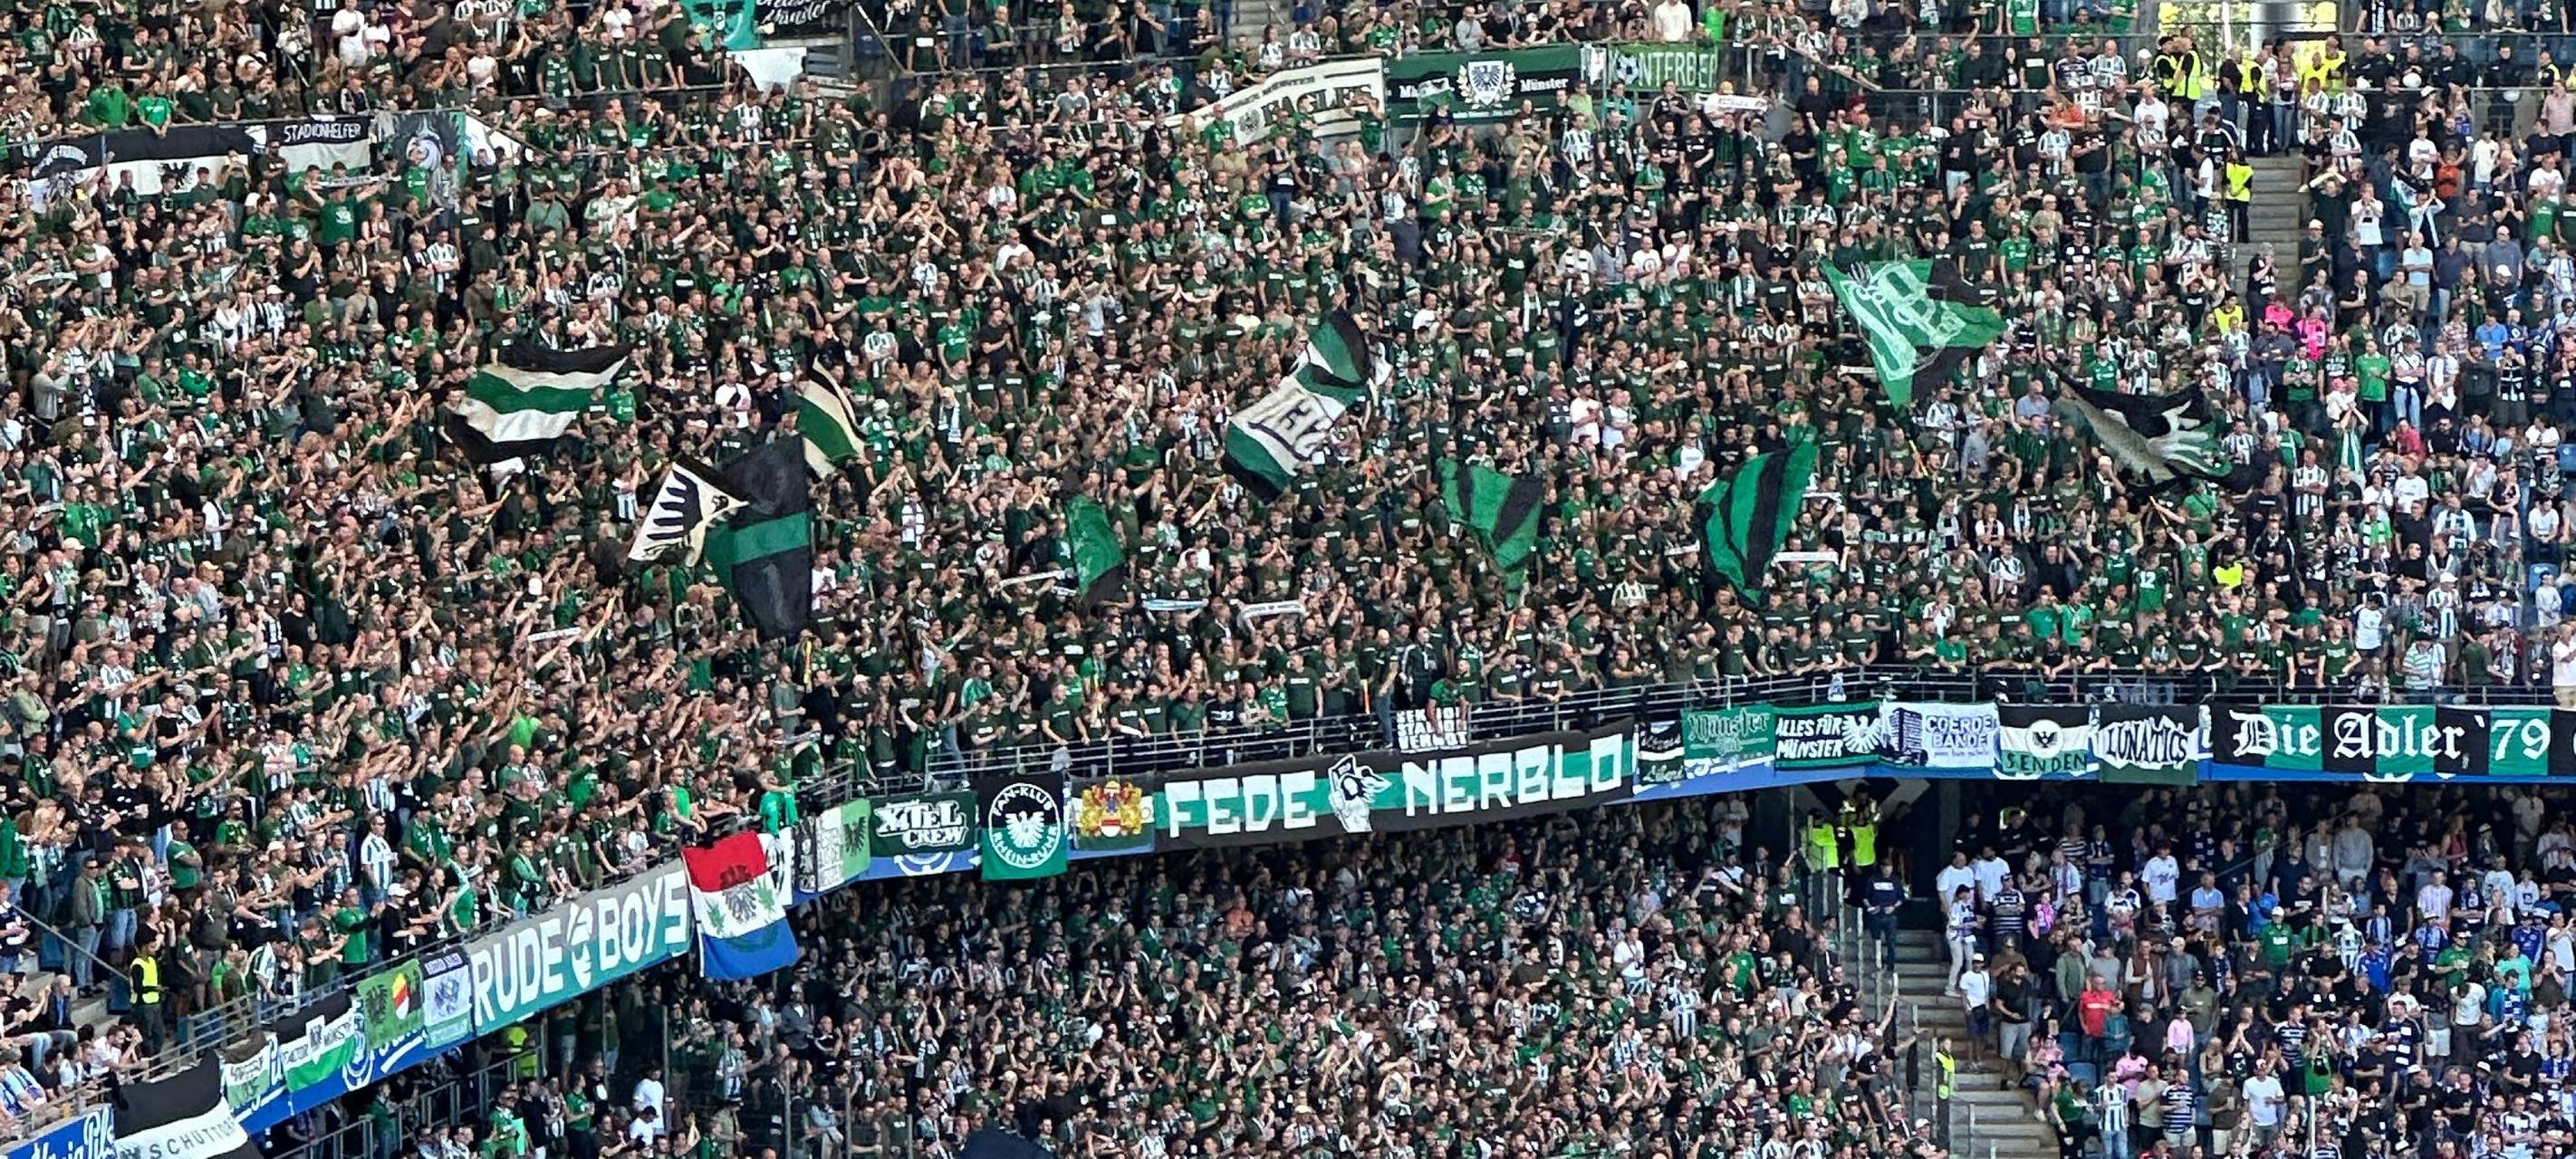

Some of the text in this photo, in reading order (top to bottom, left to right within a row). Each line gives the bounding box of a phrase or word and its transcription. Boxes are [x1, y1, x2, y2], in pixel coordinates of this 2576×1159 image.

[284, 123, 361, 142] STADIONHELFER
[2140, 571, 2155, 589] 12
[1775, 714, 1842, 737] ALLES FÜR
[1925, 714, 1995, 733] COERDE
[2229, 709, 2320, 757] Die
[2333, 712, 2465, 760] Adler
[1775, 738, 1843, 760] MÜNSTER
[1931, 733, 1989, 749] BANDE
[2106, 726, 2188, 764] LUNATICS
[2006, 752, 2087, 771] SENDEN
[1165, 734, 1622, 838] FEDE NERBLO
[993, 786, 1053, 817] FAN-KLUB
[908, 828, 966, 846] CREW
[471, 869, 689, 1027] RUDE BOYS
